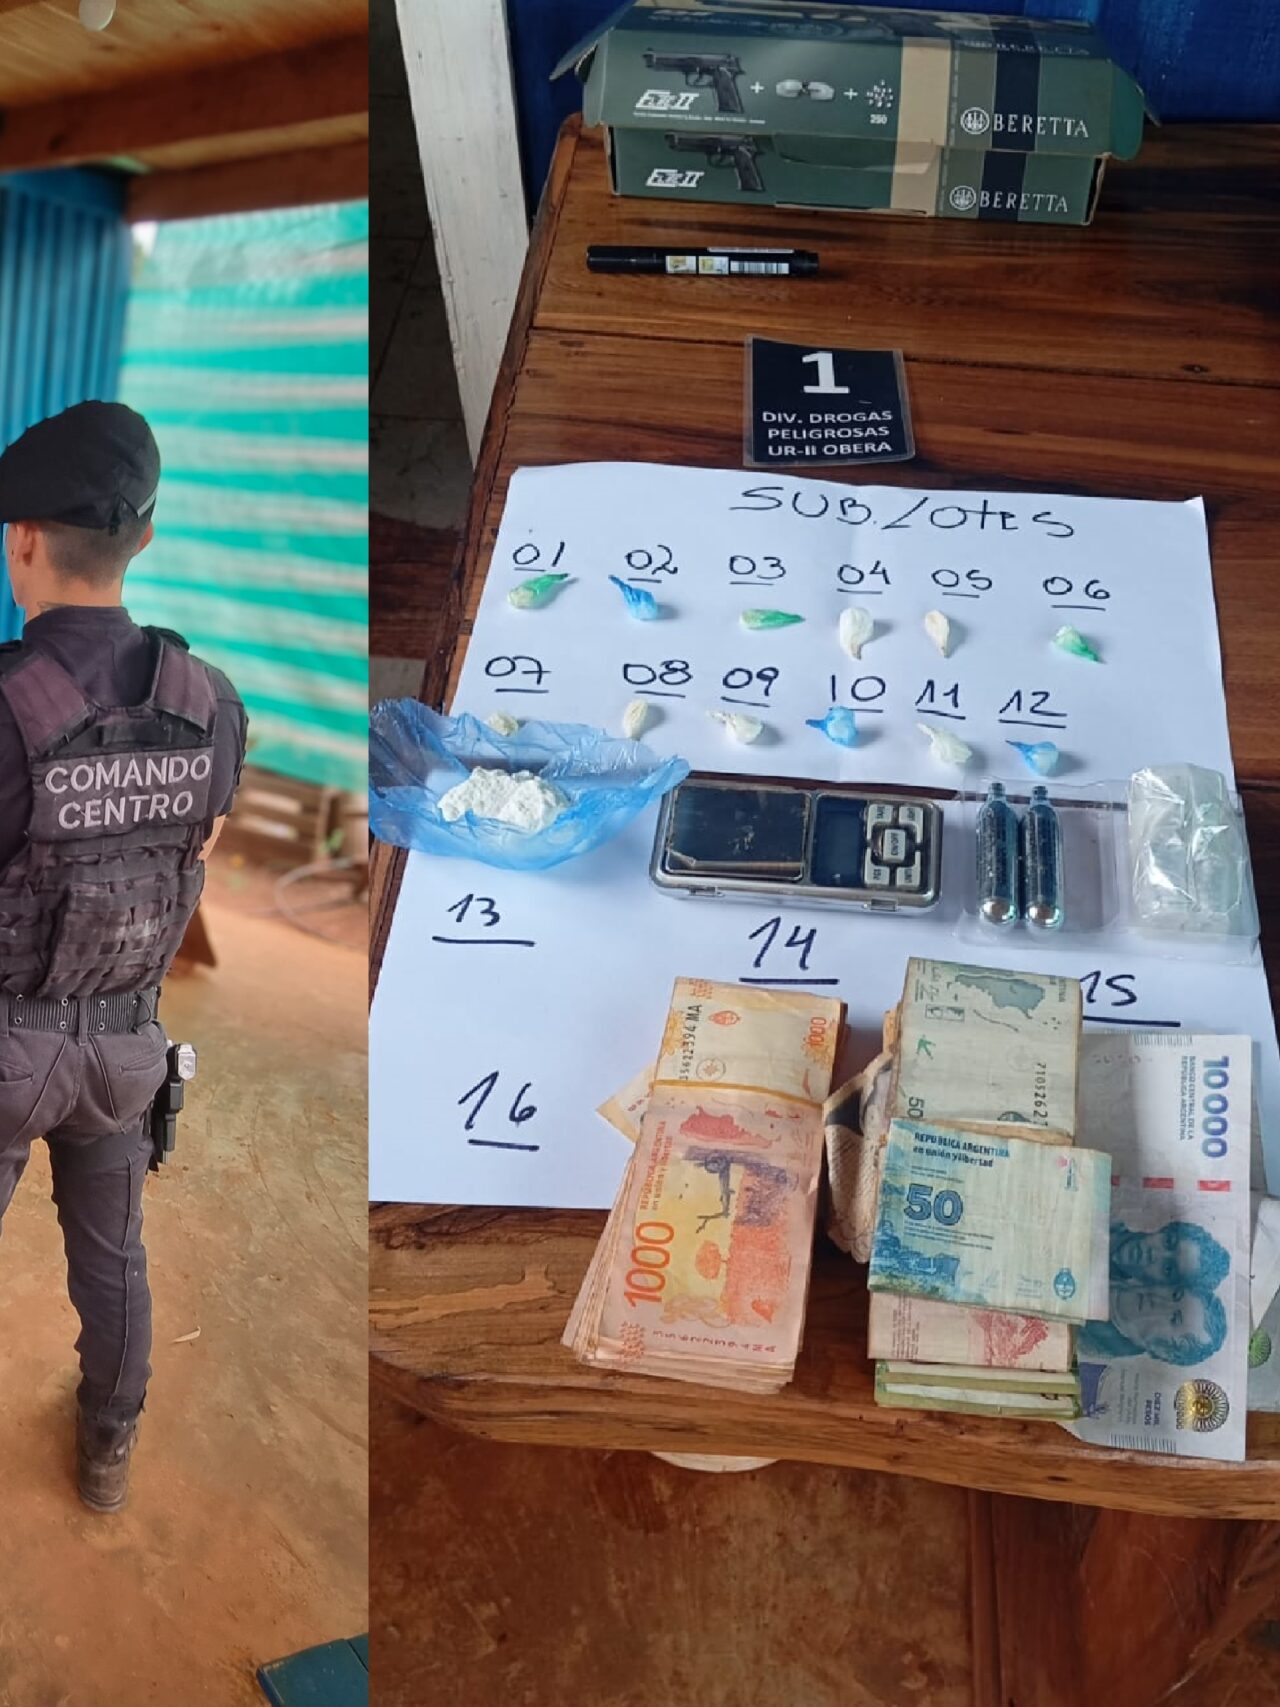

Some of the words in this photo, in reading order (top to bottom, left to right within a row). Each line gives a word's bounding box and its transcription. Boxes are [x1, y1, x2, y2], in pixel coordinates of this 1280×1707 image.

[993, 113, 1089, 138] BERETTA
[979, 190, 1068, 213] BERETTA
[802, 351, 850, 394] 1
[762, 411, 804, 424] DIV.
[809, 410, 893, 424] DROGAS
[768, 426, 890, 440] PELIGROSAS
[768, 445, 817, 456] UR-II
[823, 442, 892, 456] OBERA
[512, 541, 566, 567] 01
[625, 544, 678, 575] 02
[729, 555, 787, 580] 03
[837, 560, 891, 585] 04
[931, 569, 993, 590] 05
[1043, 576, 1110, 600] 06
[483, 655, 552, 685] 07
[623, 659, 693, 685] 08
[722, 666, 780, 696] 09
[831, 675, 886, 702] 10
[915, 679, 960, 708] 11
[998, 689, 1067, 717] 12
[44, 754, 211, 794] COMANDO
[58, 790, 194, 830] CENTRO
[446, 894, 501, 927] 13
[748, 915, 818, 970] 14
[1080, 970, 1138, 1007] 15
[457, 1070, 540, 1130] 16
[906, 1096, 925, 1121] 50
[903, 1182, 963, 1226] 50
[624, 1221, 675, 1308] 1000
